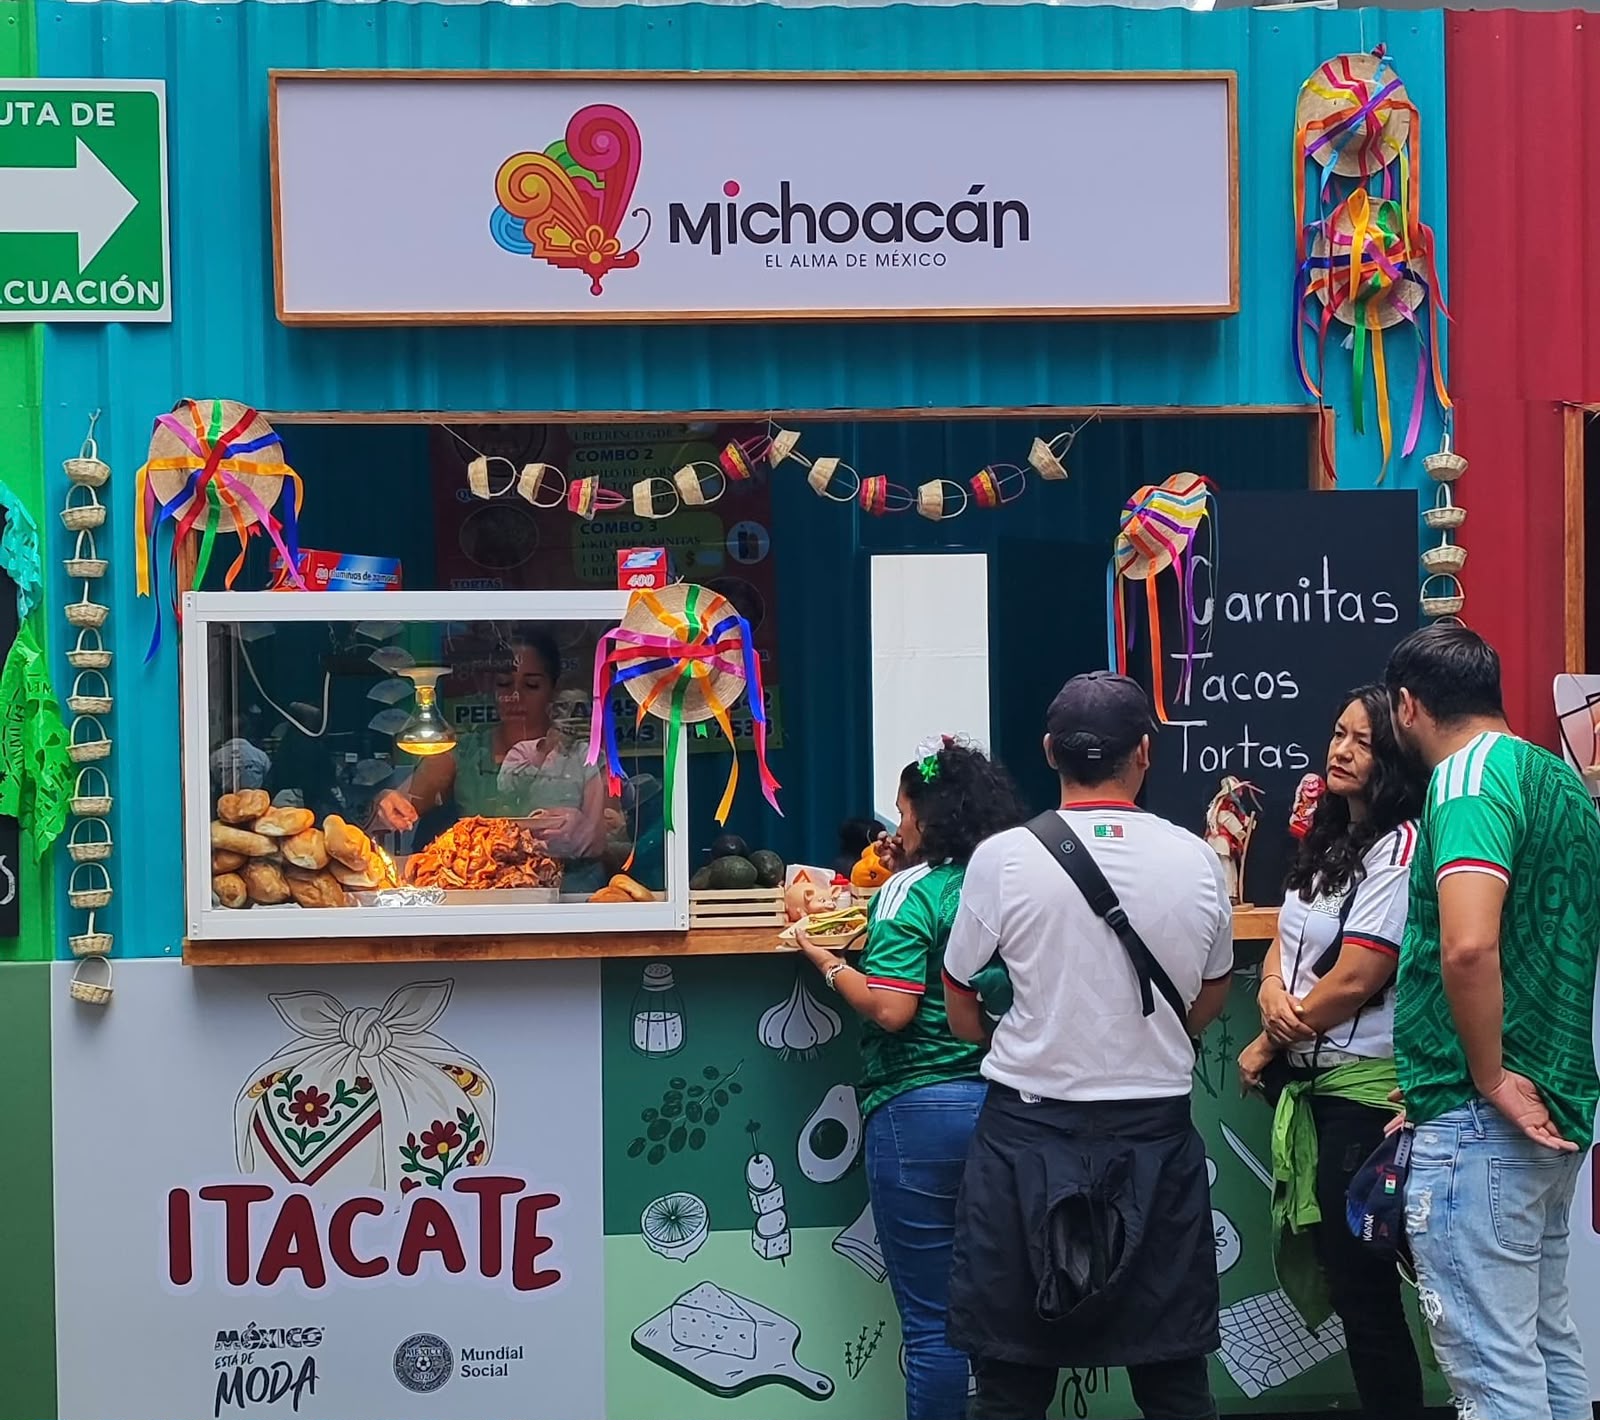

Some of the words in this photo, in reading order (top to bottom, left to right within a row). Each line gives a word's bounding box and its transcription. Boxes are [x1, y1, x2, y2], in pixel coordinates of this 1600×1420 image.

[0, 102, 60, 126] UTA
[71, 102, 115, 126] DE
[668, 180, 1030, 255] Michoacán
[765, 255, 783, 268] EL
[790, 255, 838, 268] ALMA
[846, 253, 867, 267] DE
[875, 250, 947, 267] MÉXICO
[0, 274, 159, 304] CUACIÓN
[575, 448, 640, 462] COMBO
[643, 448, 654, 460] 2
[579, 520, 643, 535] COMBO
[648, 520, 658, 532] 3
[627, 573, 655, 587] 400
[1191, 554, 1399, 625] Carnitas
[1171, 652, 1300, 706] Tacos
[1165, 720, 1311, 775] Tortas
[168, 1176, 562, 1292] ITACATE
[1362, 1214, 1374, 1241] KAYAK
[241, 1351, 256, 1366] DE
[460, 1345, 524, 1361] Mundial
[460, 1363, 509, 1378] Social
[214, 1355, 321, 1418] MODA
